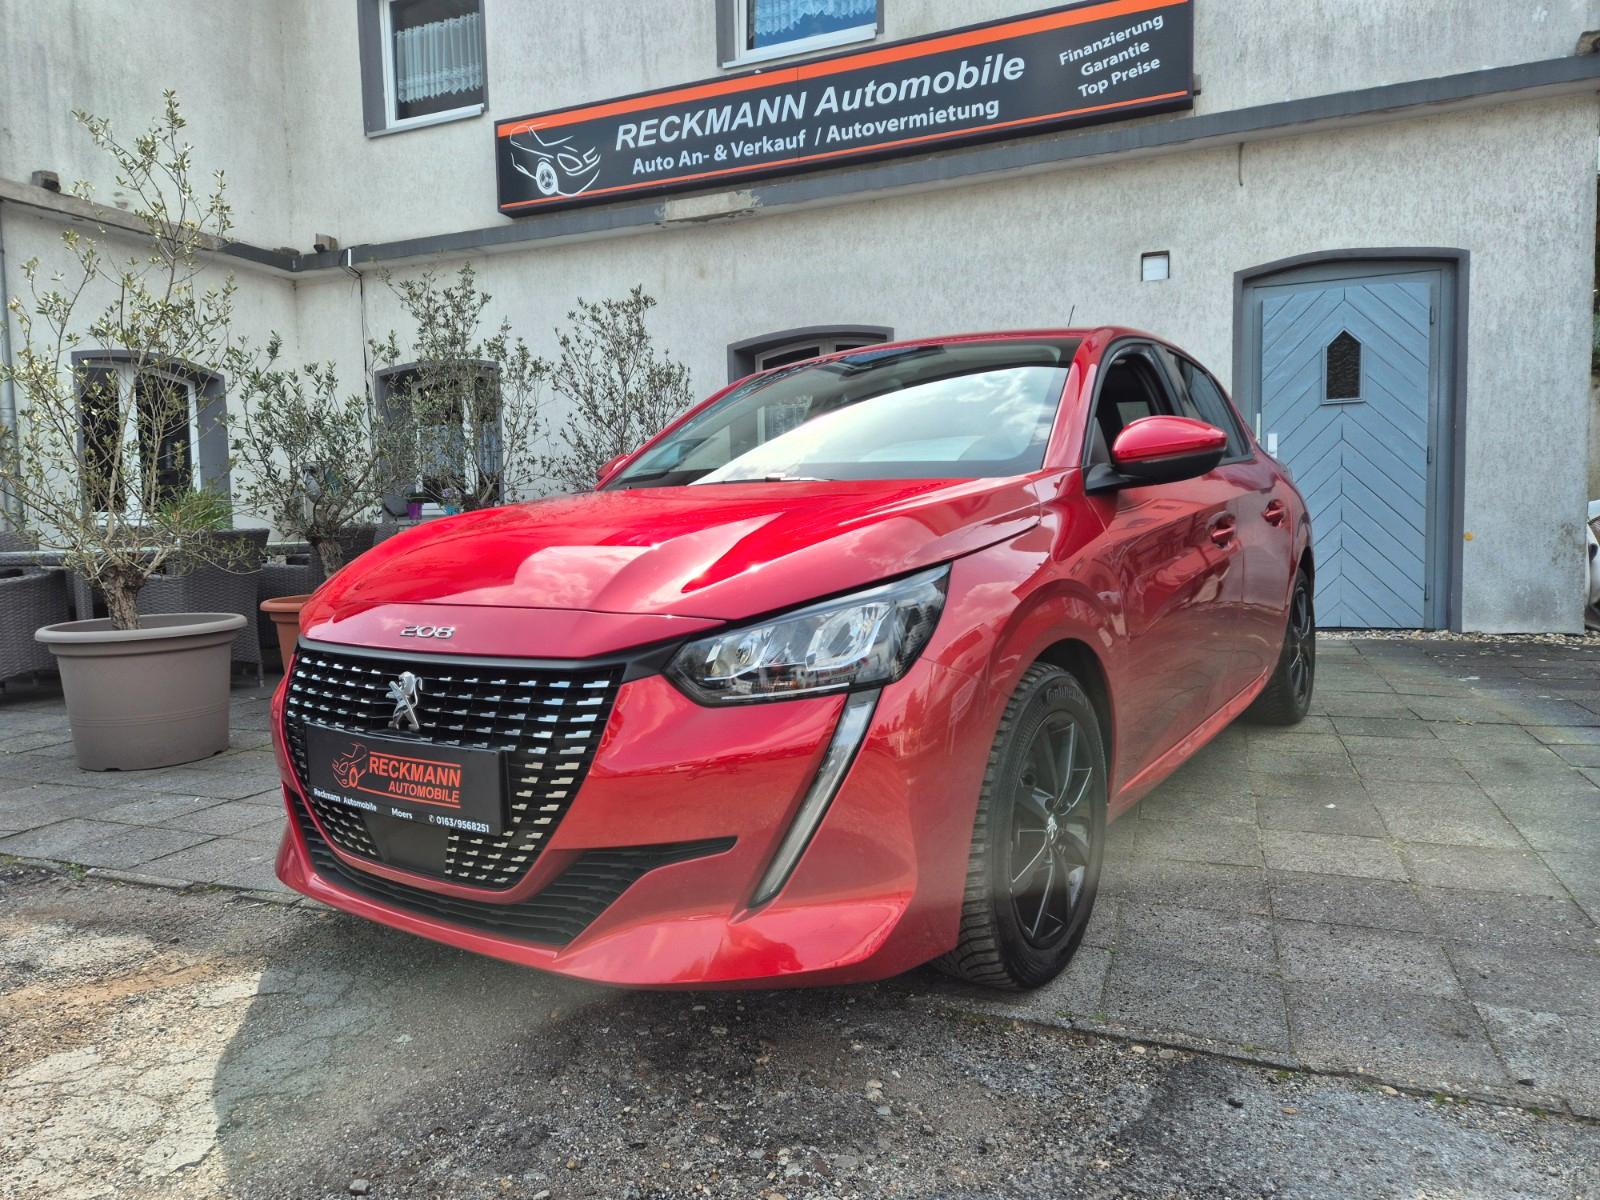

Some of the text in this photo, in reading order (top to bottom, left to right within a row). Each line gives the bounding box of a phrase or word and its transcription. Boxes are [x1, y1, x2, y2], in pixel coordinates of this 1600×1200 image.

[1059, 13, 1164, 66] Finanzierung
[1078, 56, 1161, 98] Top Preise
[1080, 40, 1150, 77] Garantie
[615, 53, 1025, 152] RECKMANN Automobile
[632, 156, 674, 176] Auto
[678, 150, 711, 168] An-
[714, 144, 728, 161] &
[731, 130, 807, 158] Verkauf
[825, 100, 999, 144] Autovermietung
[400, 625, 455, 639] 208
[369, 756, 461, 788] RECKMANN
[343, 796, 377, 812] Automobile
[391, 807, 413, 820] Moers
[388, 780, 460, 804] AUTOMOBILE
